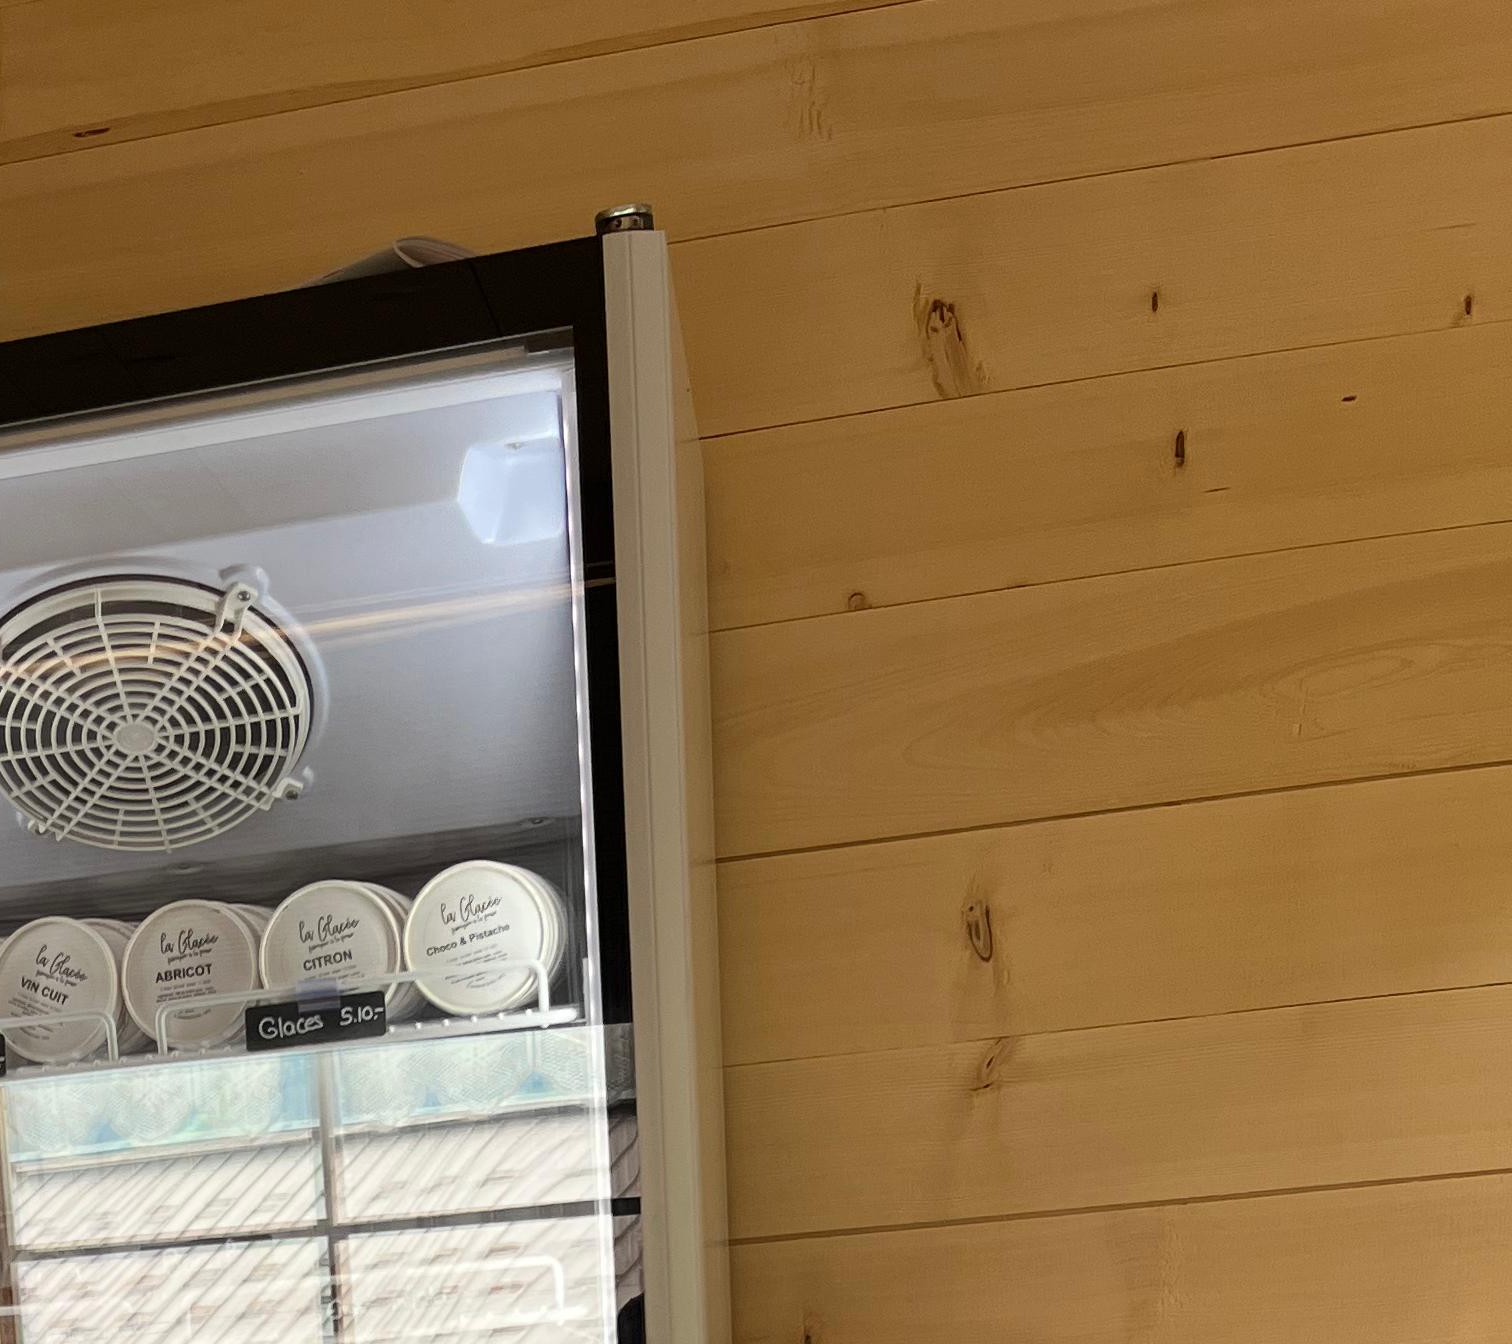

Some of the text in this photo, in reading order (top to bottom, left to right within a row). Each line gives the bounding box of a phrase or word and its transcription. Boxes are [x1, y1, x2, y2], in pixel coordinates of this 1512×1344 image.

[426, 941, 457, 957] Choco
[469, 924, 510, 943] Pistache
[303, 949, 353, 971] CITRON
[155, 963, 212, 984] ABRICOT
[21, 976, 40, 993] VIN
[41, 986, 69, 1005] CUIT
[258, 1014, 324, 1039] Glaces
